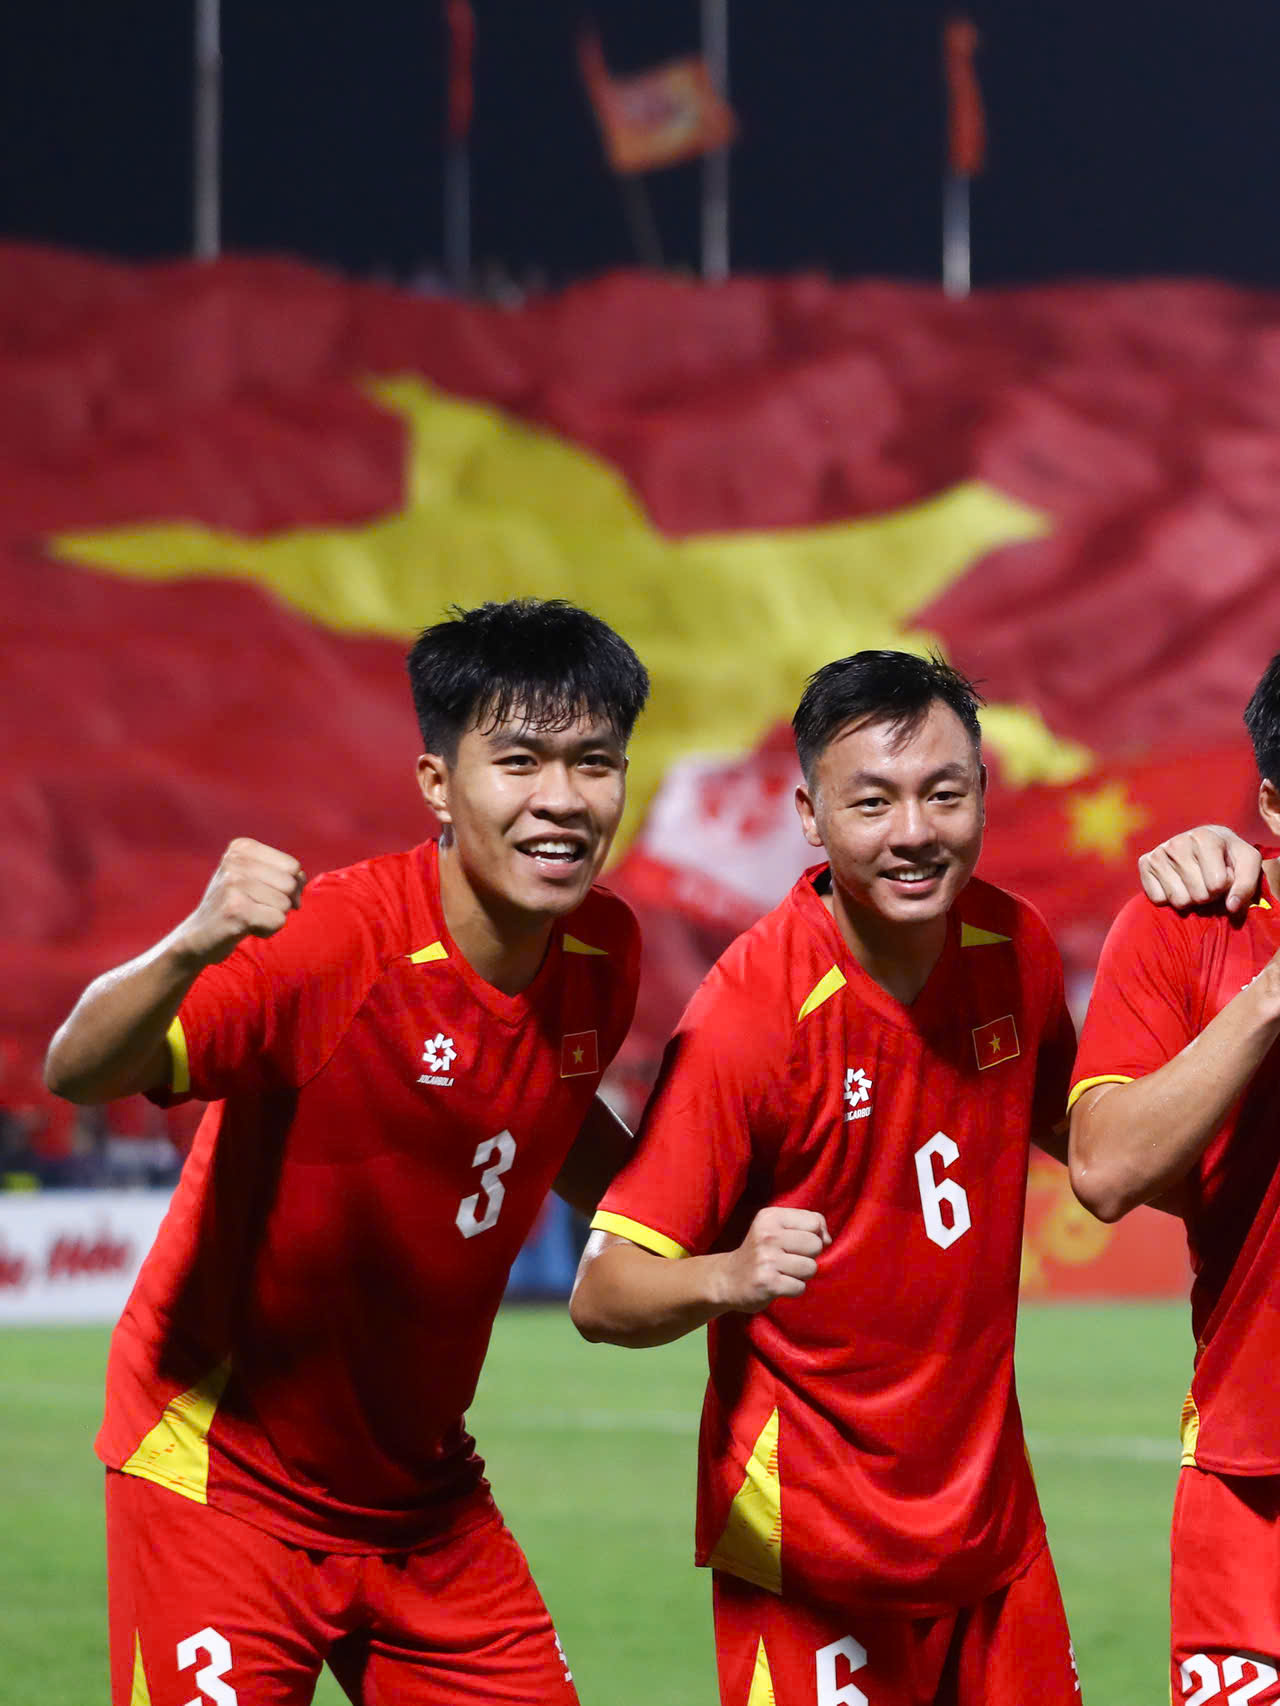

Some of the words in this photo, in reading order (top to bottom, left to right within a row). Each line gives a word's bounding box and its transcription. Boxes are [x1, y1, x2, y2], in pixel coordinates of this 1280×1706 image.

[455, 1129, 517, 1239] 3
[914, 1131, 971, 1250] 6
[176, 1626, 238, 1706] 3
[815, 1635, 869, 1706] 6
